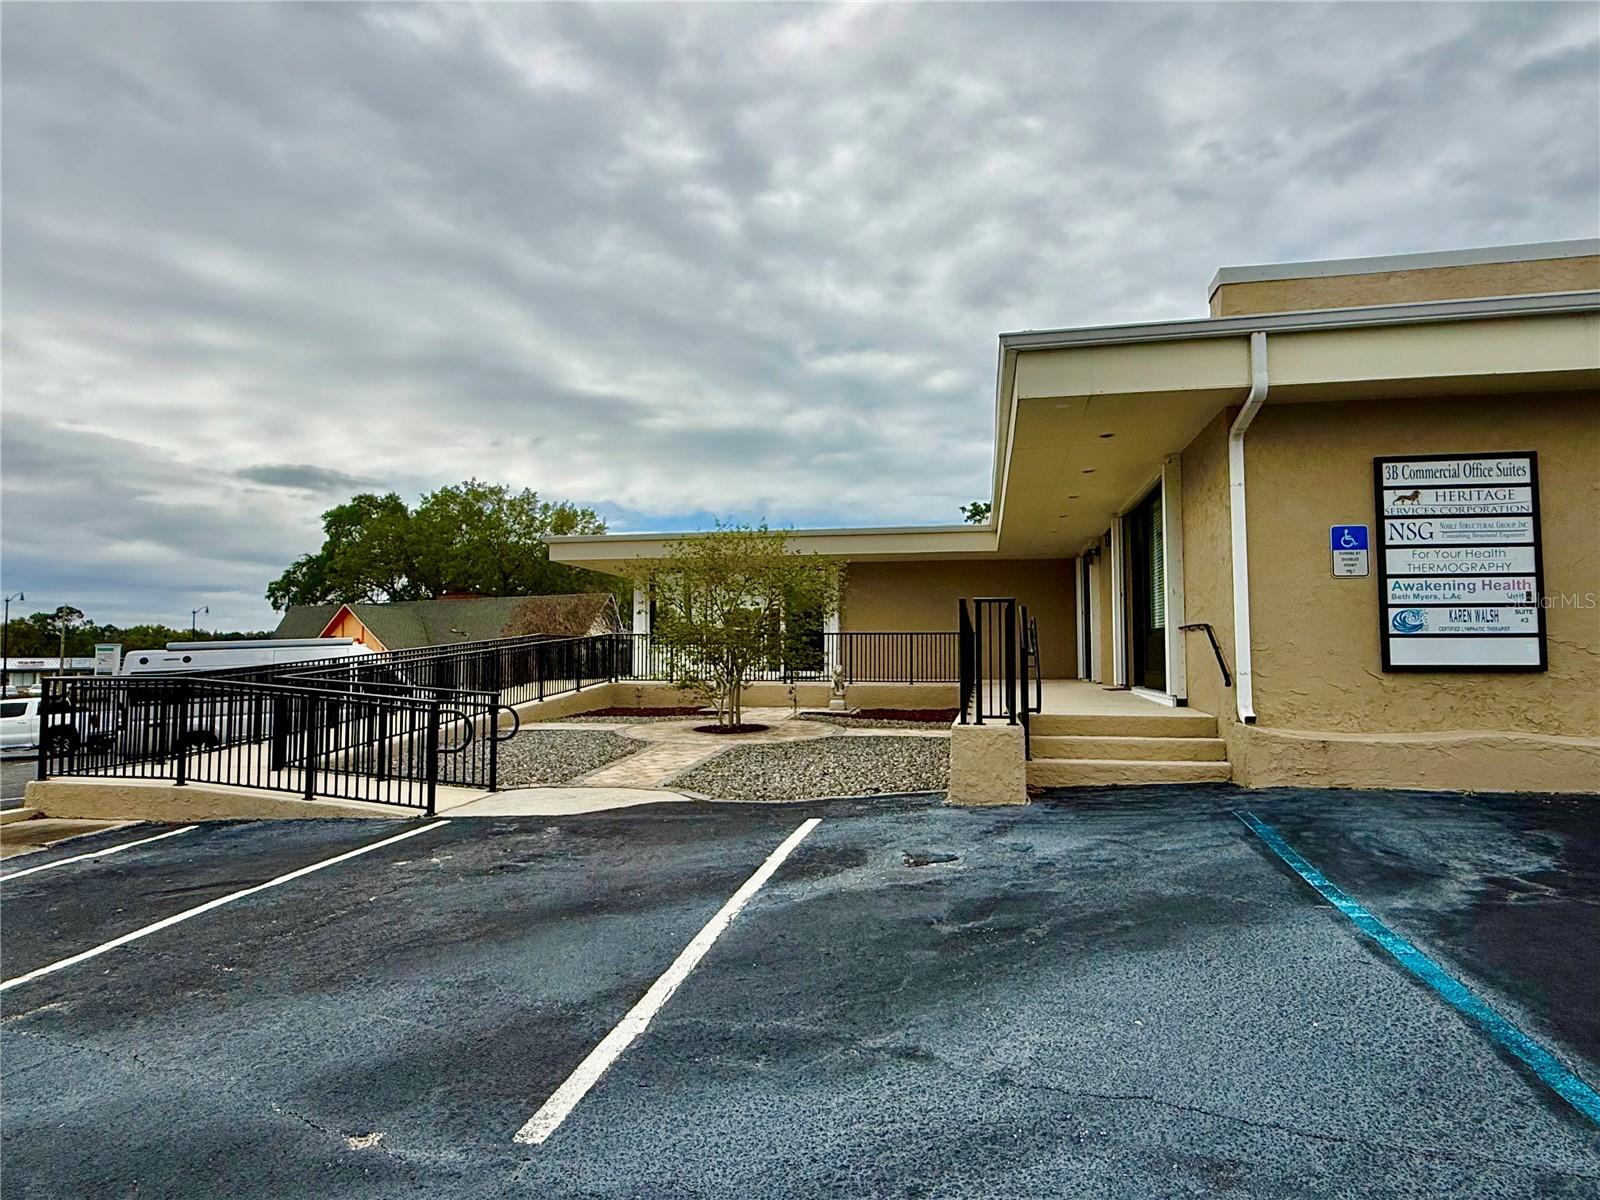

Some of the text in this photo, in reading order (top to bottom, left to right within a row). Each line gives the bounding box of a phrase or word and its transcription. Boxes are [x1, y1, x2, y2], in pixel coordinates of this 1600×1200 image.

[1385, 462, 1526, 480] 3B Commercial Office Suites
[1435, 489, 1516, 502] HERITAGE
[1385, 504, 1530, 515] SERVICES CORPORATION
[1389, 522, 1434, 541] NSG
[1411, 549, 1506, 558] For Your Health
[1407, 562, 1512, 572] THERMOGRAPHY
[1392, 579, 1532, 593] Awakening Health
[1507, 592, 1525, 600] Unit
[1449, 609, 1499, 623] KAREN WALSH
